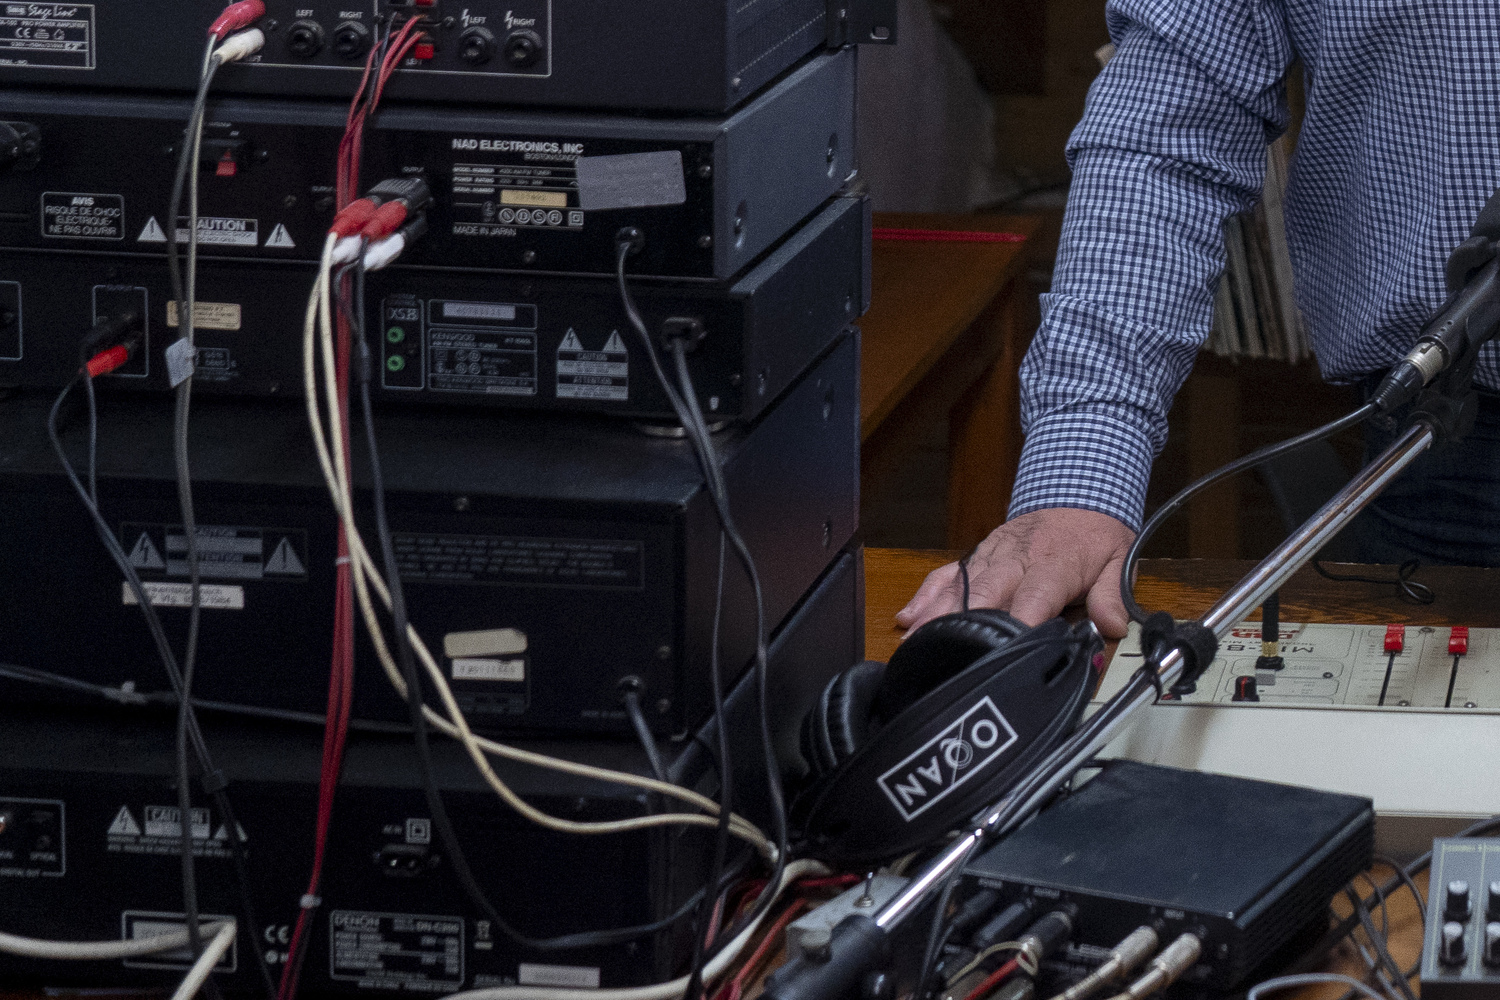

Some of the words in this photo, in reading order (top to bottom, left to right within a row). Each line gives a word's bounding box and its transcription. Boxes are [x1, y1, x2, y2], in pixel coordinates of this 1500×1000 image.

[295, 9, 314, 17] LEFT
[339, 11, 363, 19] RIGHT
[513, 18, 535, 26] RIGHT
[452, 138, 478, 150] NAD
[71, 197, 95, 206] AVIS
[45, 205, 78, 215] RISQUE
[79, 206, 92, 215] DE
[93, 207, 121, 217] CHOC
[49, 225, 62, 234] NE
[63, 225, 81, 235] PAS
[82, 226, 117, 236] OUVRIR
[187, 219, 246, 231] AUTION
[453, 226, 479, 235] MADE
[480, 227, 489, 235] IN
[490, 227, 517, 237] JAPAN
[895, 718, 999, 806] OQAN
